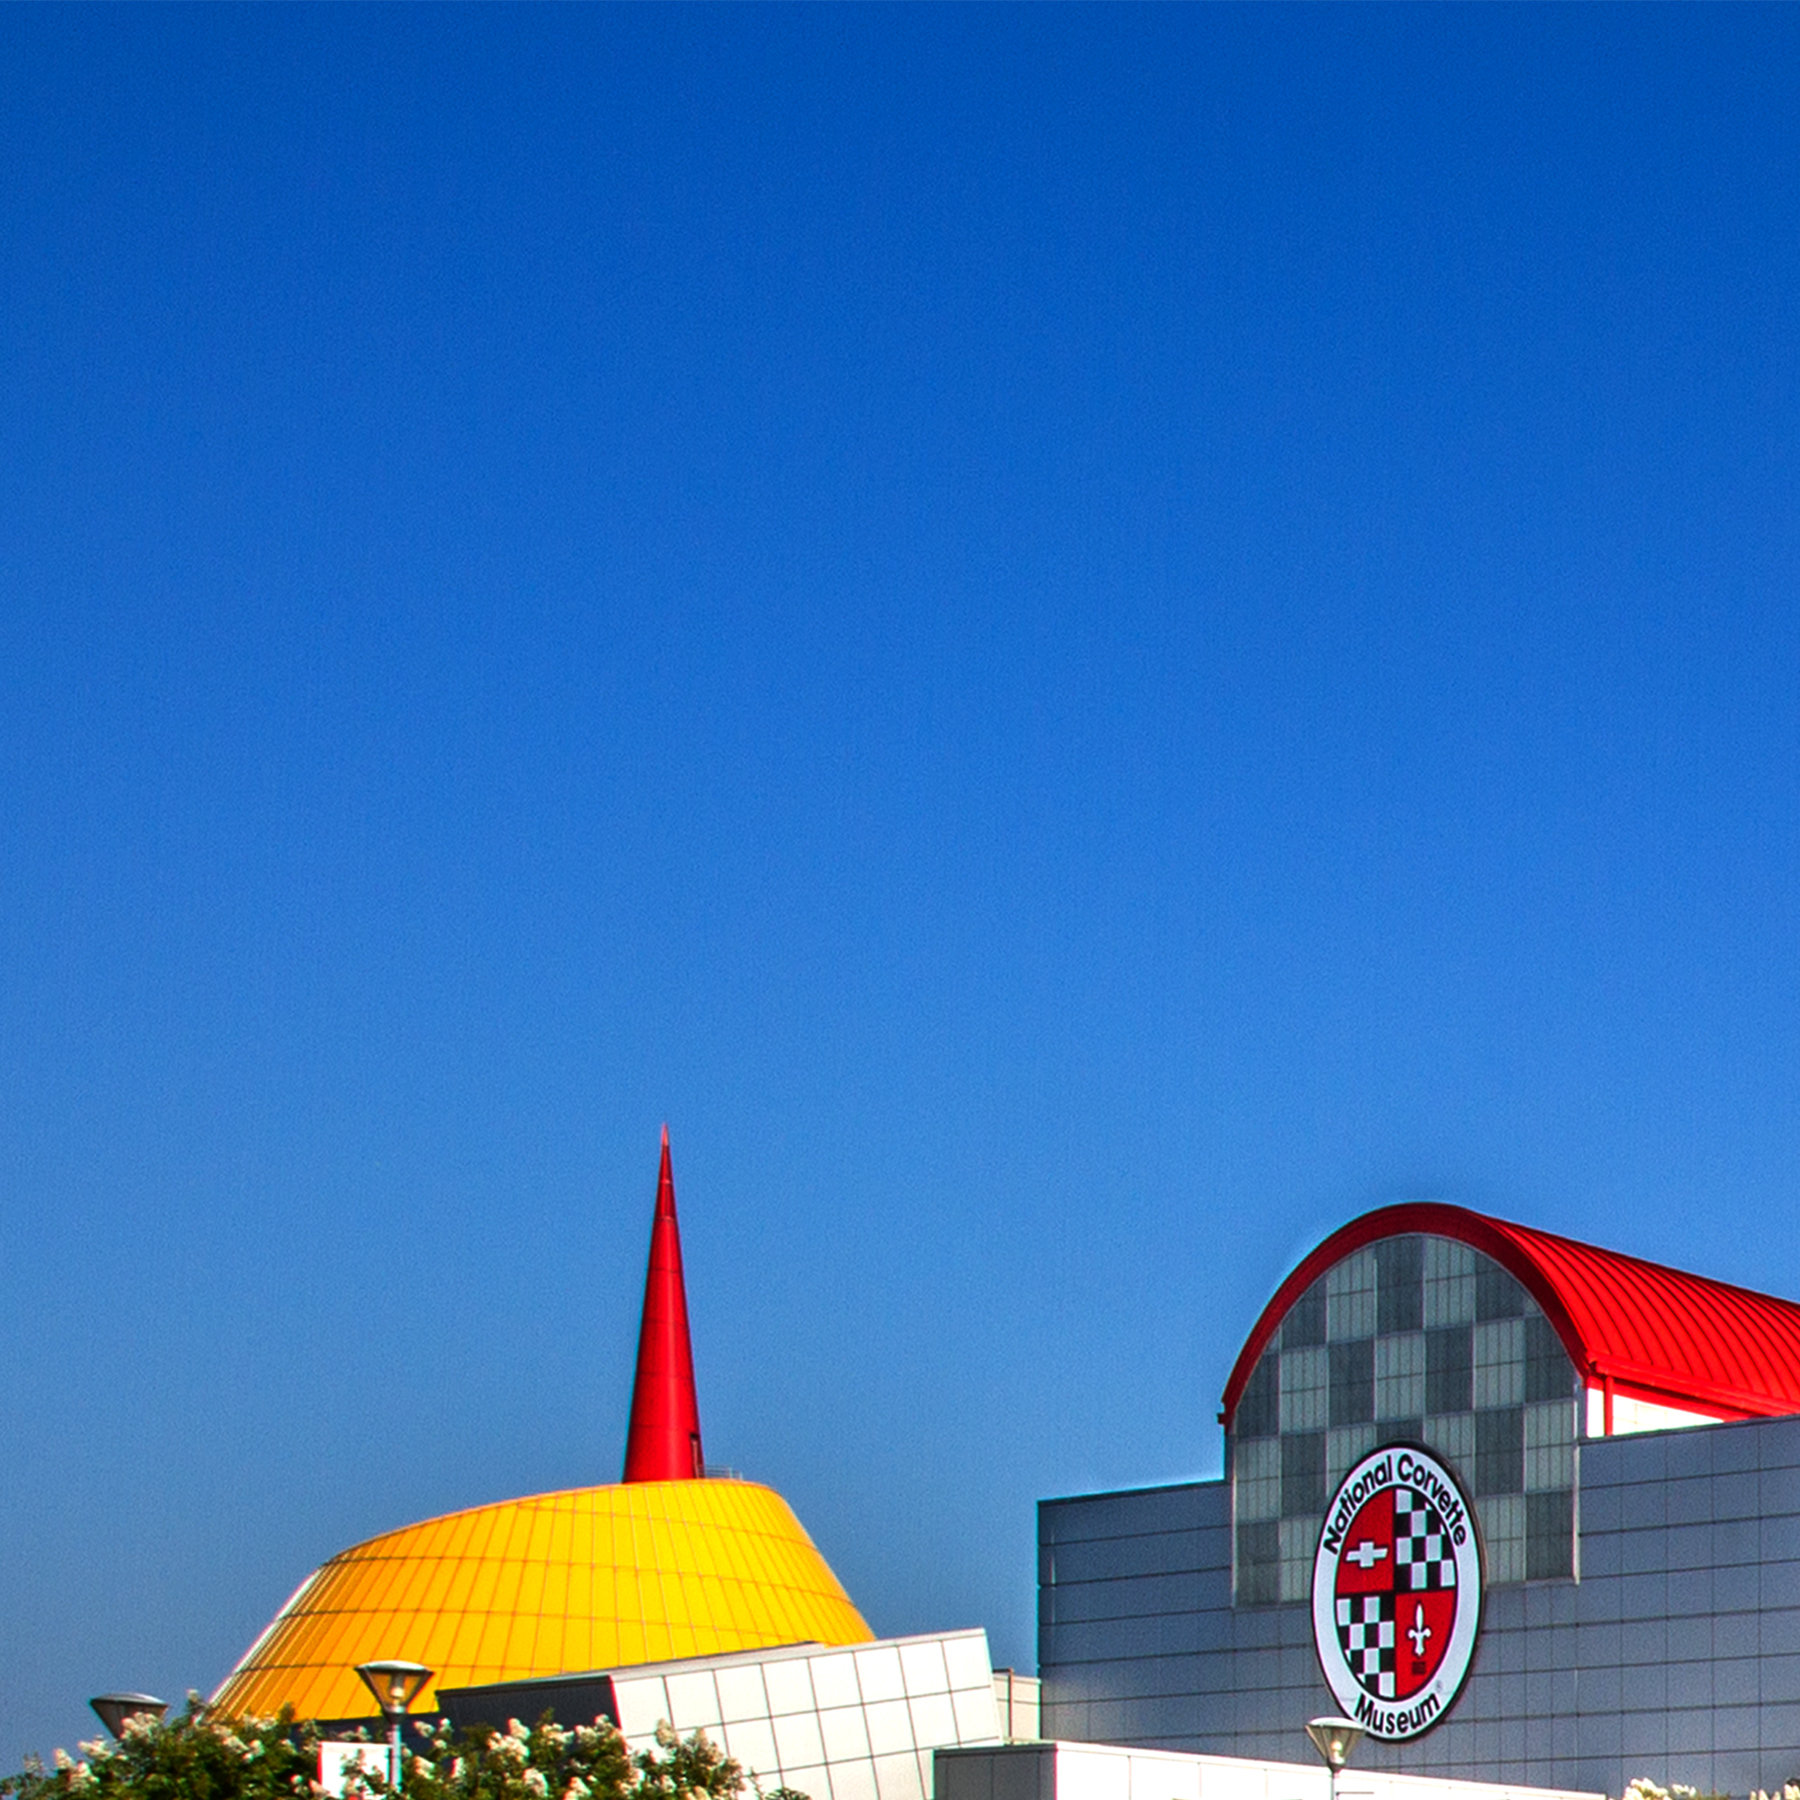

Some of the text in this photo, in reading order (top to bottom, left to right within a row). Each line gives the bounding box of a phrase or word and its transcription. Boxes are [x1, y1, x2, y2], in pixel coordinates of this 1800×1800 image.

[1323, 1453, 1467, 1555] National Corvette
[1354, 1692, 1441, 1732] Museum
